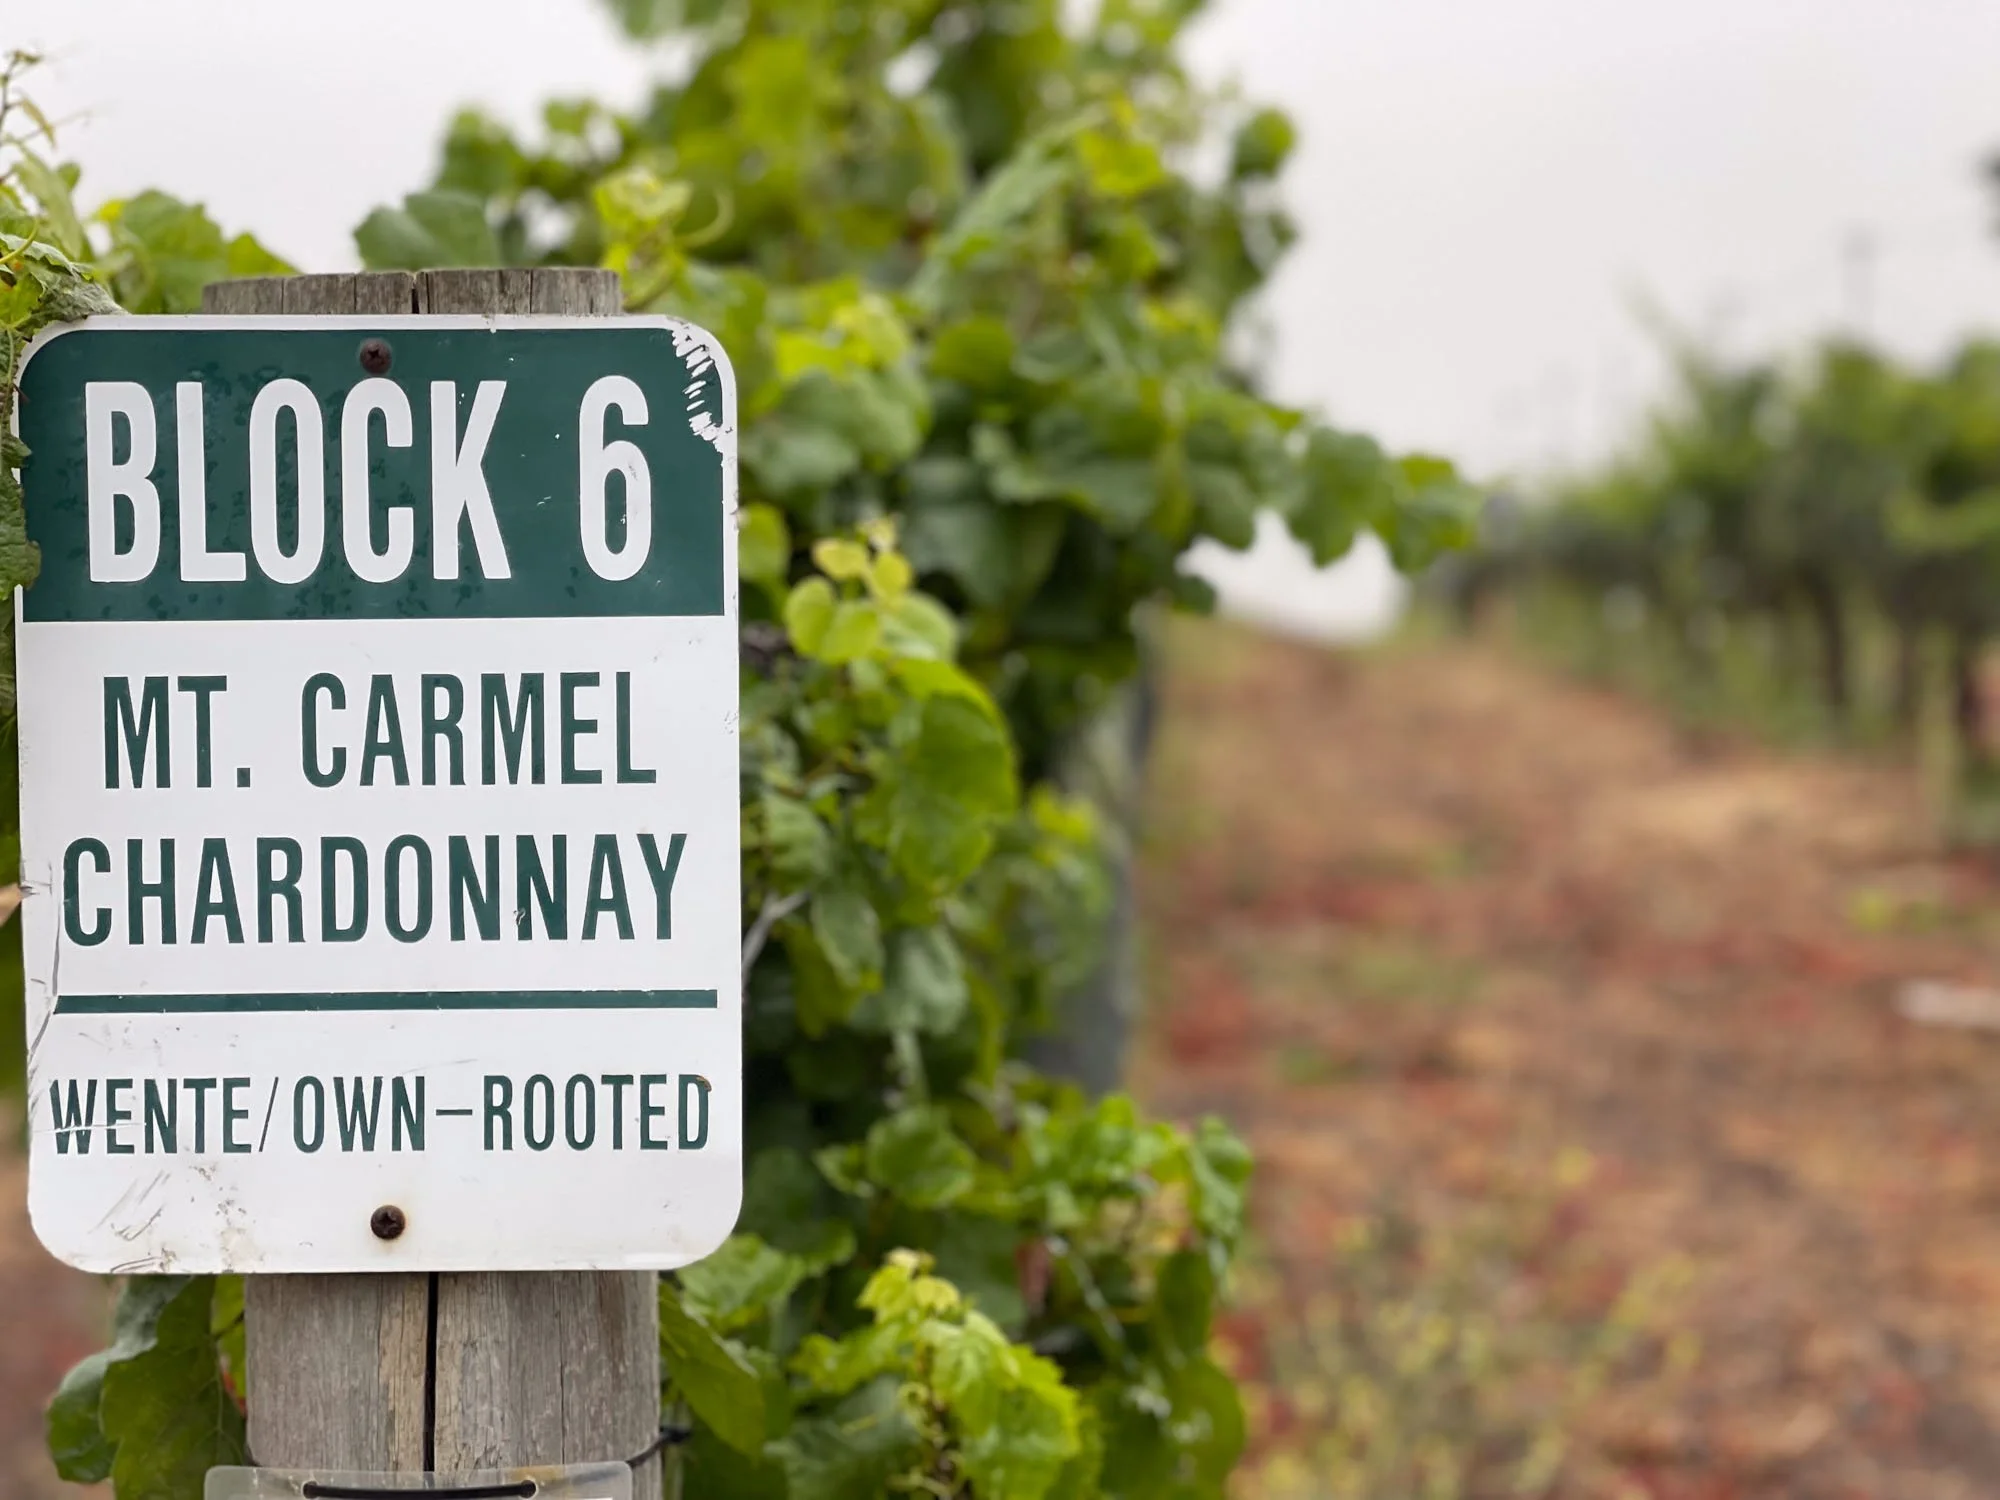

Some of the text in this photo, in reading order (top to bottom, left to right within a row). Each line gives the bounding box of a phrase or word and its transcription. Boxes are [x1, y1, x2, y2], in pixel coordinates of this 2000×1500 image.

[85, 374, 652, 585] BLOCK 6
[103, 670, 657, 789] MT. CARMEL
[63, 832, 687, 947] CHARDONNAY
